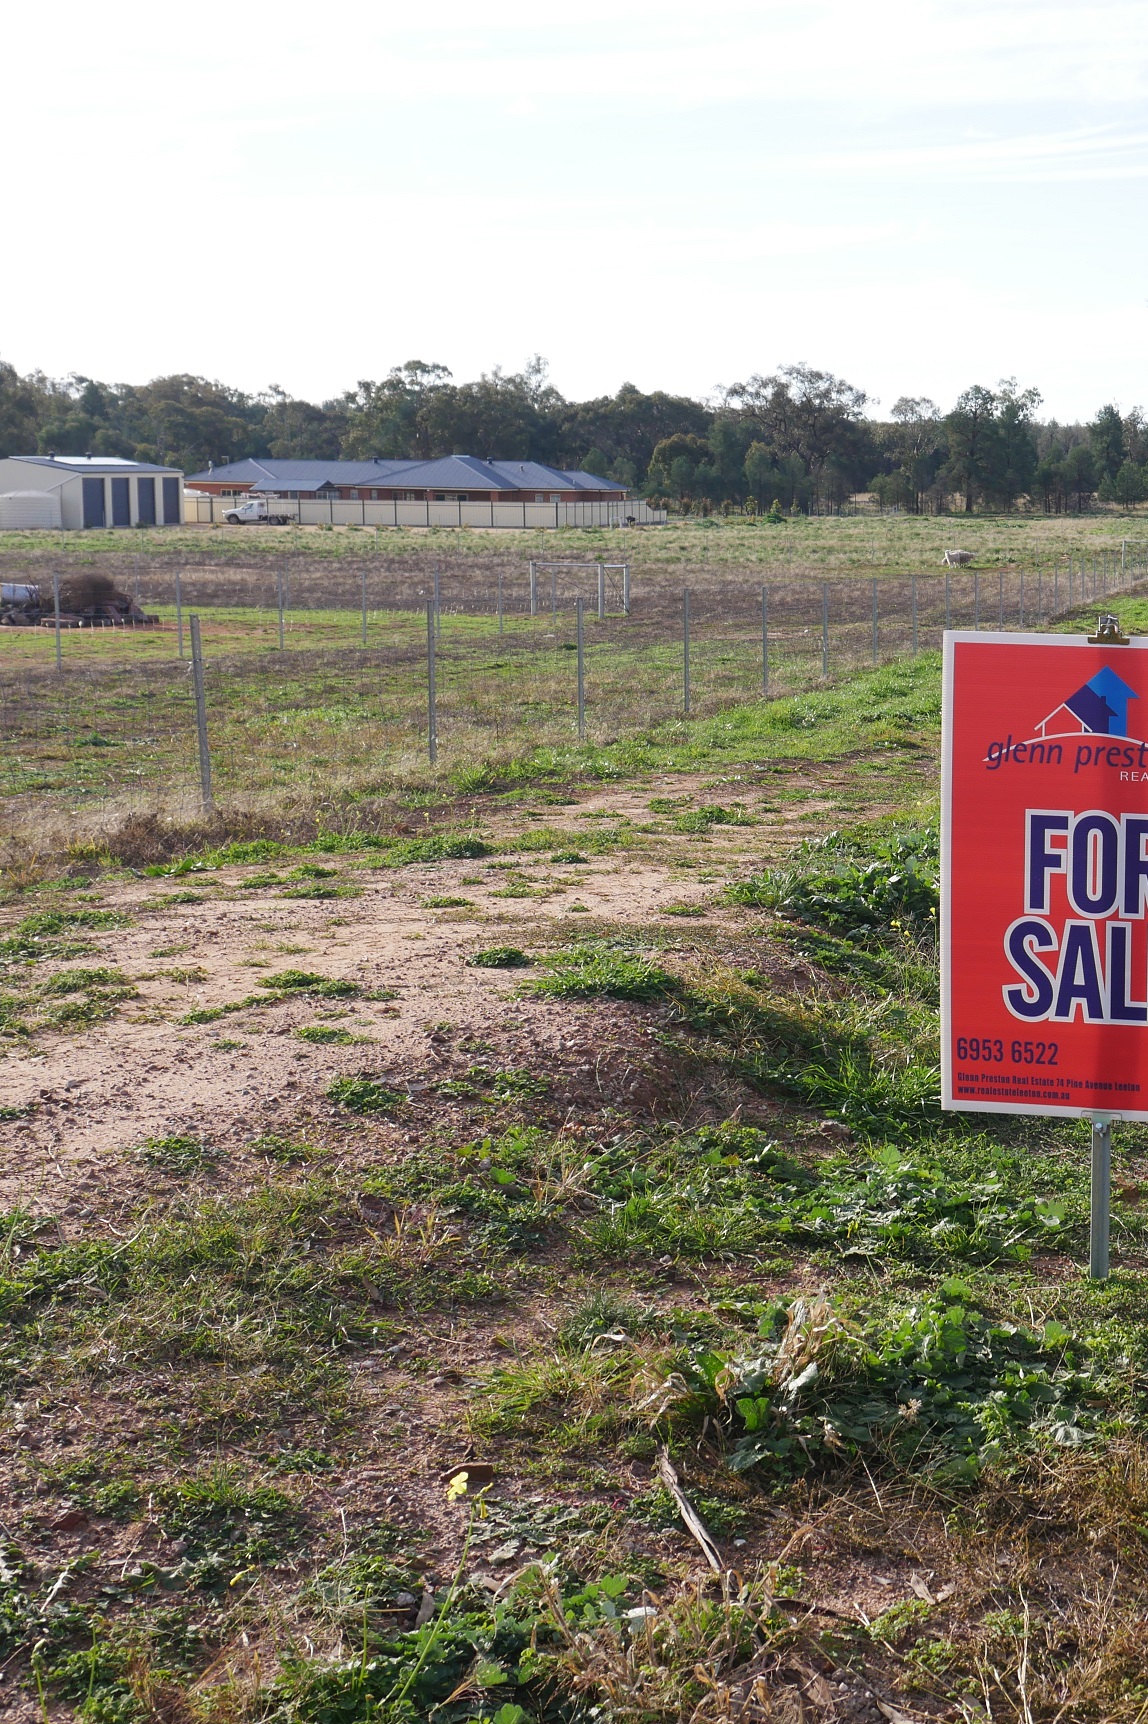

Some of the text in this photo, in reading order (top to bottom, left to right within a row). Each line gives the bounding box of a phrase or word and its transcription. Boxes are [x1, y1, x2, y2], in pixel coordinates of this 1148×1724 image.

[986, 734, 1063, 770] glenn
[957, 1037, 1059, 1065] 6953 6522
[957, 1072, 979, 1082] Glenn
[981, 1073, 1010, 1084] Preston
[1012, 1076, 1029, 1085] Real
[1031, 1077, 1054, 1087] Estate
[1066, 1079, 1083, 1089] Pine
[1085, 1080, 1113, 1091] Avenue
[1115, 1082, 1141, 1092] Leeton
[958, 1086, 1070, 1100] www.realestateleeton.com.au
